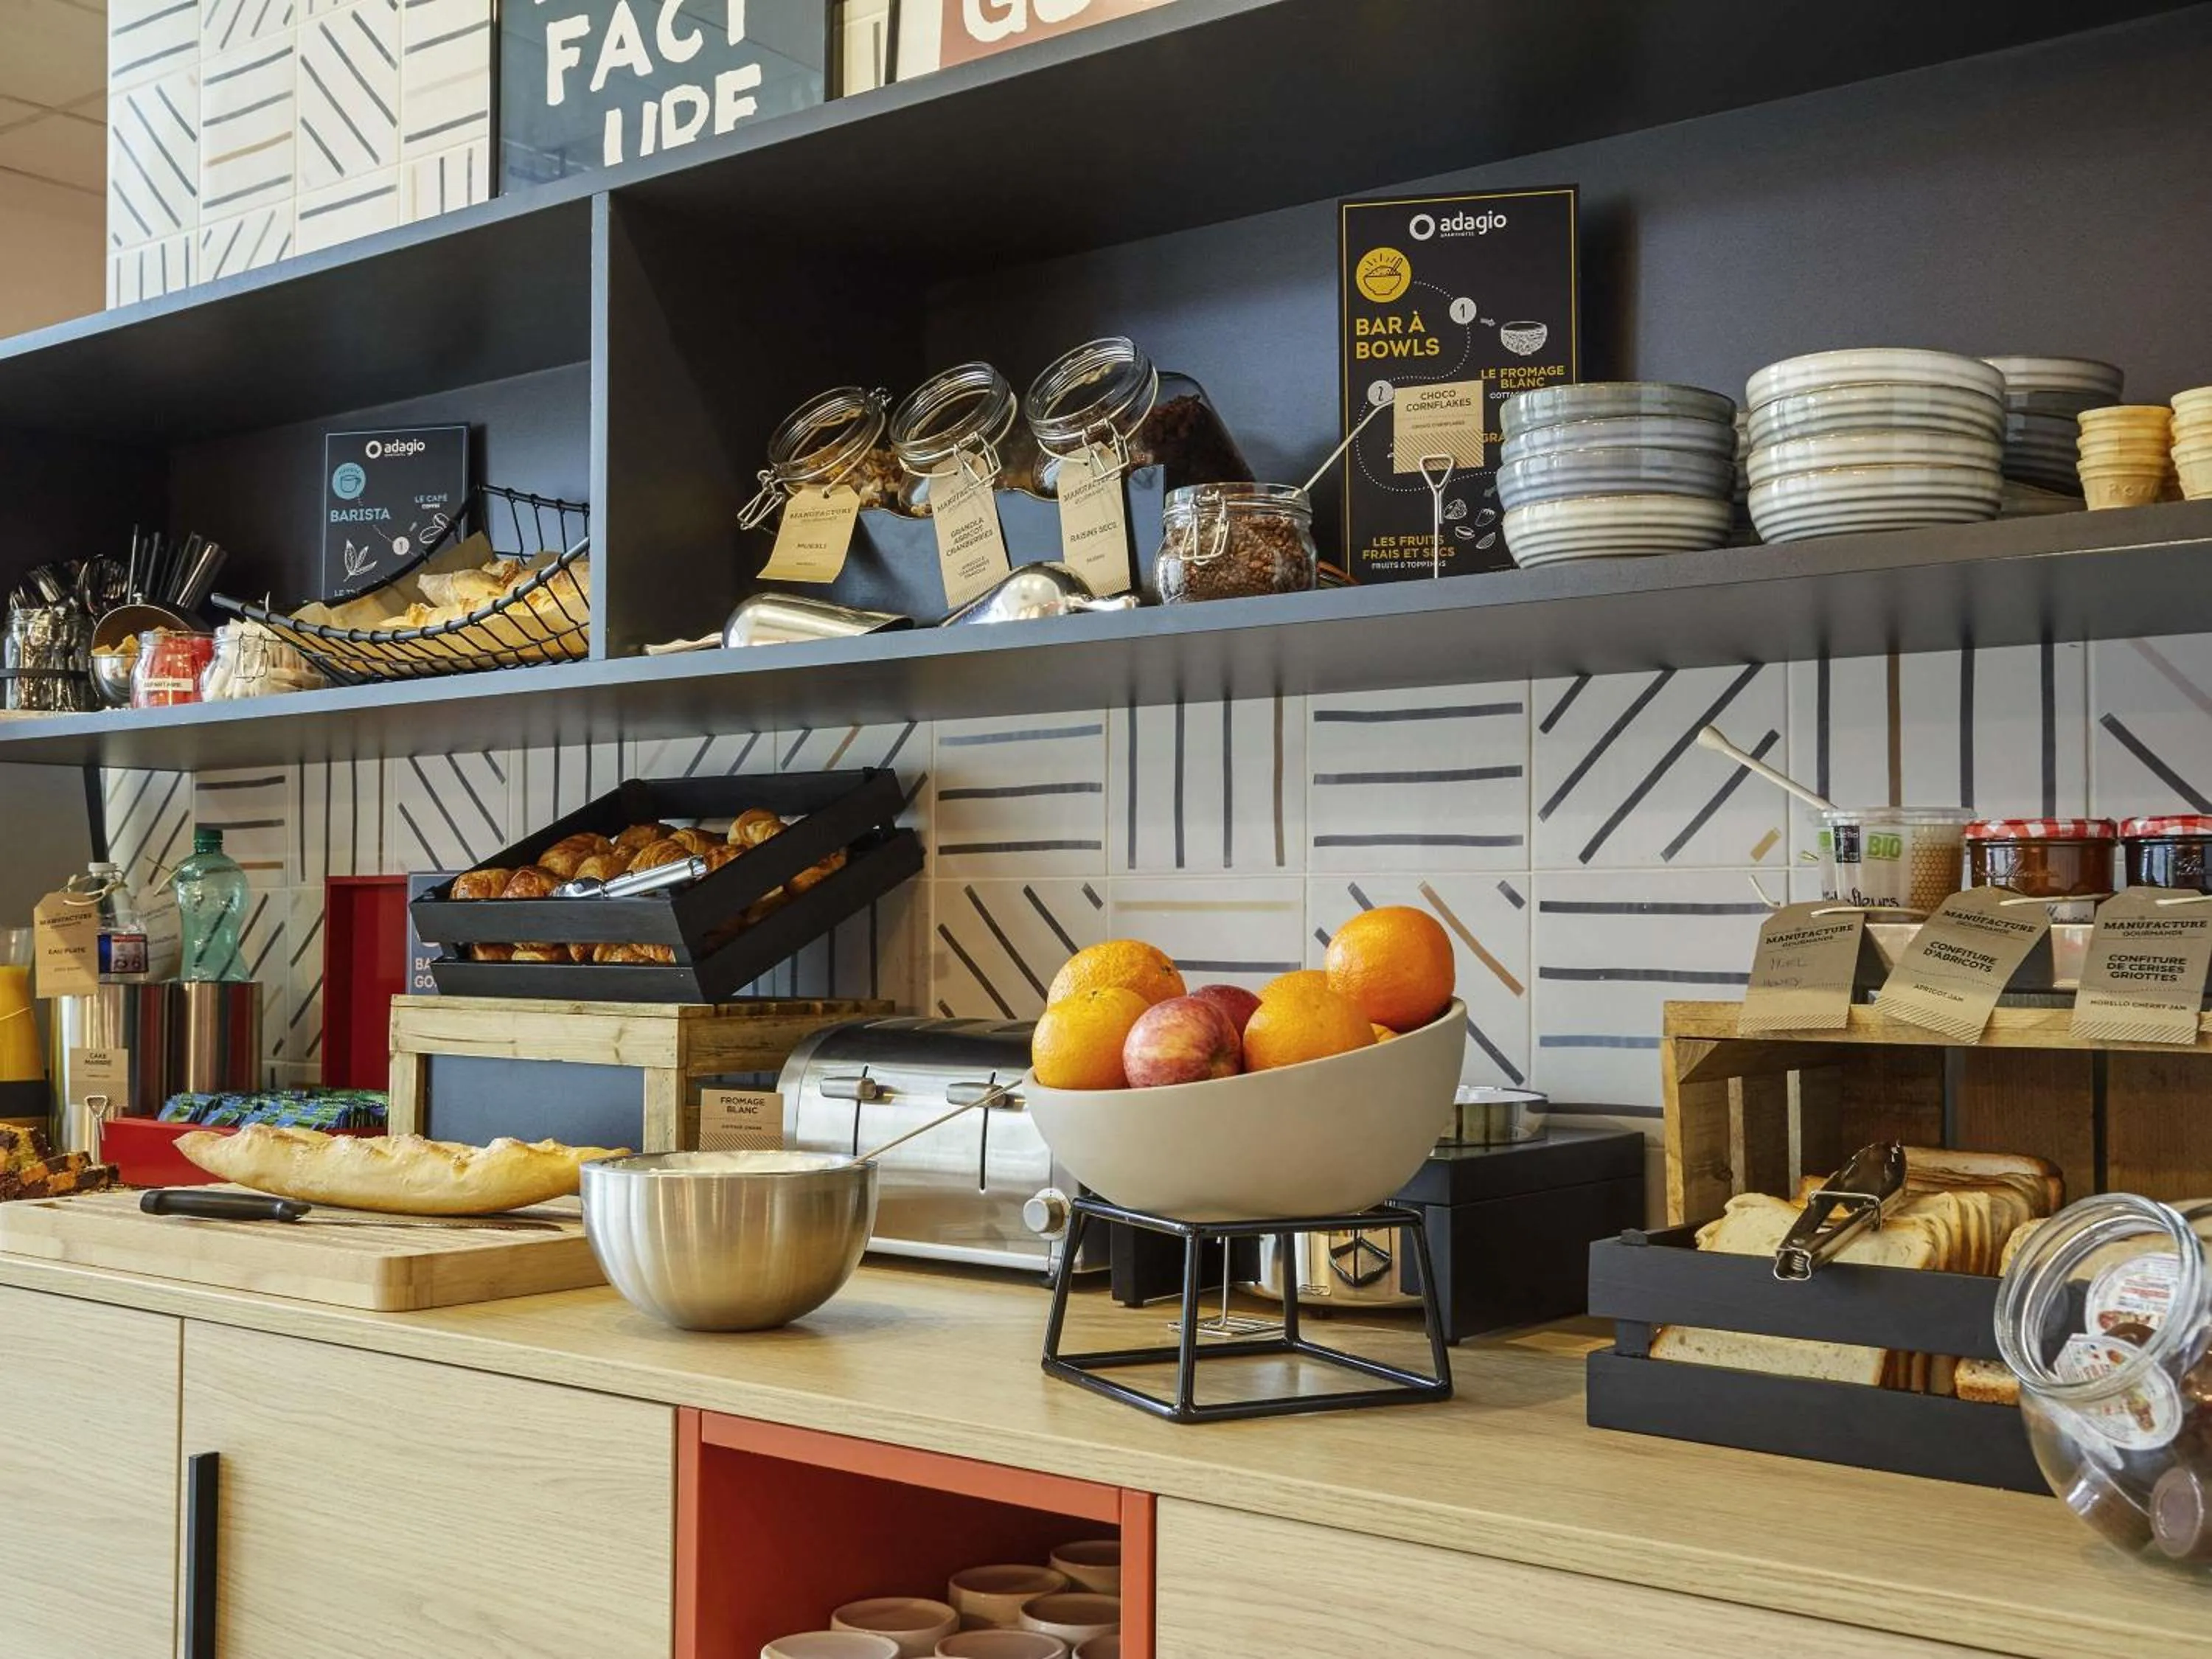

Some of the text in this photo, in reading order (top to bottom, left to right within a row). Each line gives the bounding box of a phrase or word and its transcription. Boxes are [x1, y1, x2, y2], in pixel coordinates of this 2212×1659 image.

[1440, 210, 1506, 235] adagio
[1458, 303, 1466, 319] 1
[1356, 316, 1402, 335] BAR
[1356, 337, 1440, 359] BOWLS
[1481, 365, 1565, 379] LE FROMAGE
[1500, 377, 1545, 389] BLANC
[1420, 389, 1456, 400] CHOCO
[1406, 398, 1472, 411] CORNFLAKES
[384, 439, 425, 455] adagio
[414, 495, 425, 504] LE
[330, 507, 391, 522] BARISTA
[1373, 535, 1444, 546] LES FRUITS
[1363, 549, 1399, 560] FRAIS
[1403, 548, 1419, 558] ET
[1868, 835, 1903, 858] BIO
[1944, 910, 2037, 933] MANUFACTURE
[2104, 921, 2207, 930] MANUFACTURE
[1766, 924, 1854, 944] MANUFACTURE
[1923, 947, 1993, 973] D'ABRICOTS
[1930, 942, 1997, 965] CONFITURE
[2109, 954, 2187, 965] CONFITURE
[2129, 964, 2185, 974] CERISES
[414, 975, 437, 988] GO
[2110, 972, 2177, 982] GRIOTTES
[720, 1097, 765, 1106] FROMAGE
[727, 1106, 759, 1114] BLANC
